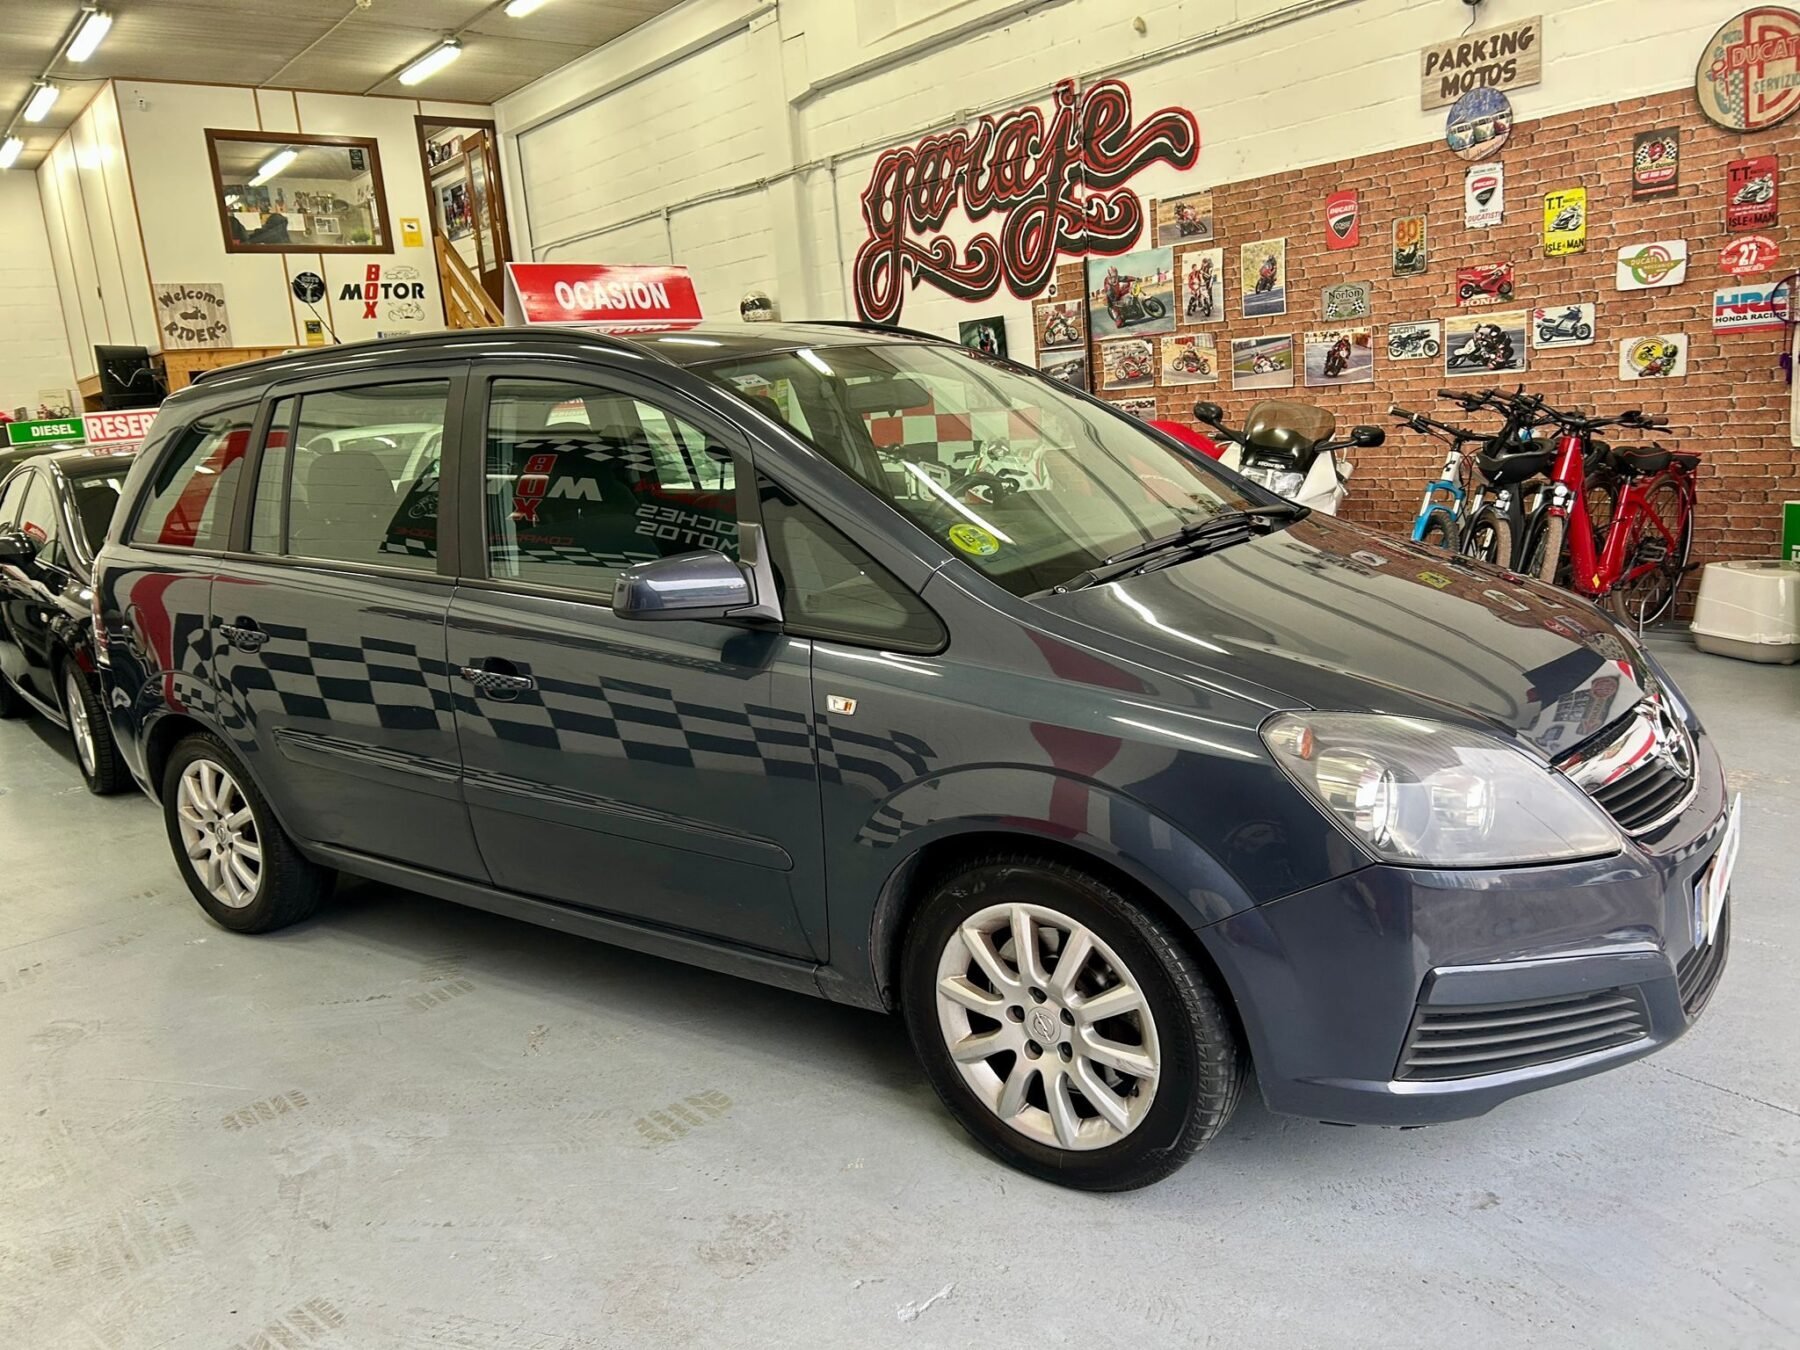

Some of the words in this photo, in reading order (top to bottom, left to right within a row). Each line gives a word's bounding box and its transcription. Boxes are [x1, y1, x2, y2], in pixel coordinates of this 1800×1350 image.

[1425, 26, 1535, 76] PARKING
[1732, 35, 1800, 68] DUCAT
[1441, 58, 1518, 98] MOTOS
[853, 79, 1201, 327] garaje
[1329, 204, 1355, 214] DUCATI
[1545, 242, 1562, 252] ISLE
[1567, 238, 1585, 249] MAN
[1738, 243, 1759, 266] 27
[158, 285, 225, 308] Welcome
[554, 281, 671, 311] OCASION
[1327, 287, 1364, 301] Norton
[1459, 297, 1507, 307] HOND
[1716, 288, 1788, 317] HRC
[1715, 315, 1748, 323] HONDA
[1750, 311, 1787, 320] RACING
[163, 320, 227, 343] RIDERS
[30, 423, 76, 437] DIESEL
[87, 412, 157, 439] RESER
[1257, 461, 1286, 469] HONDA
